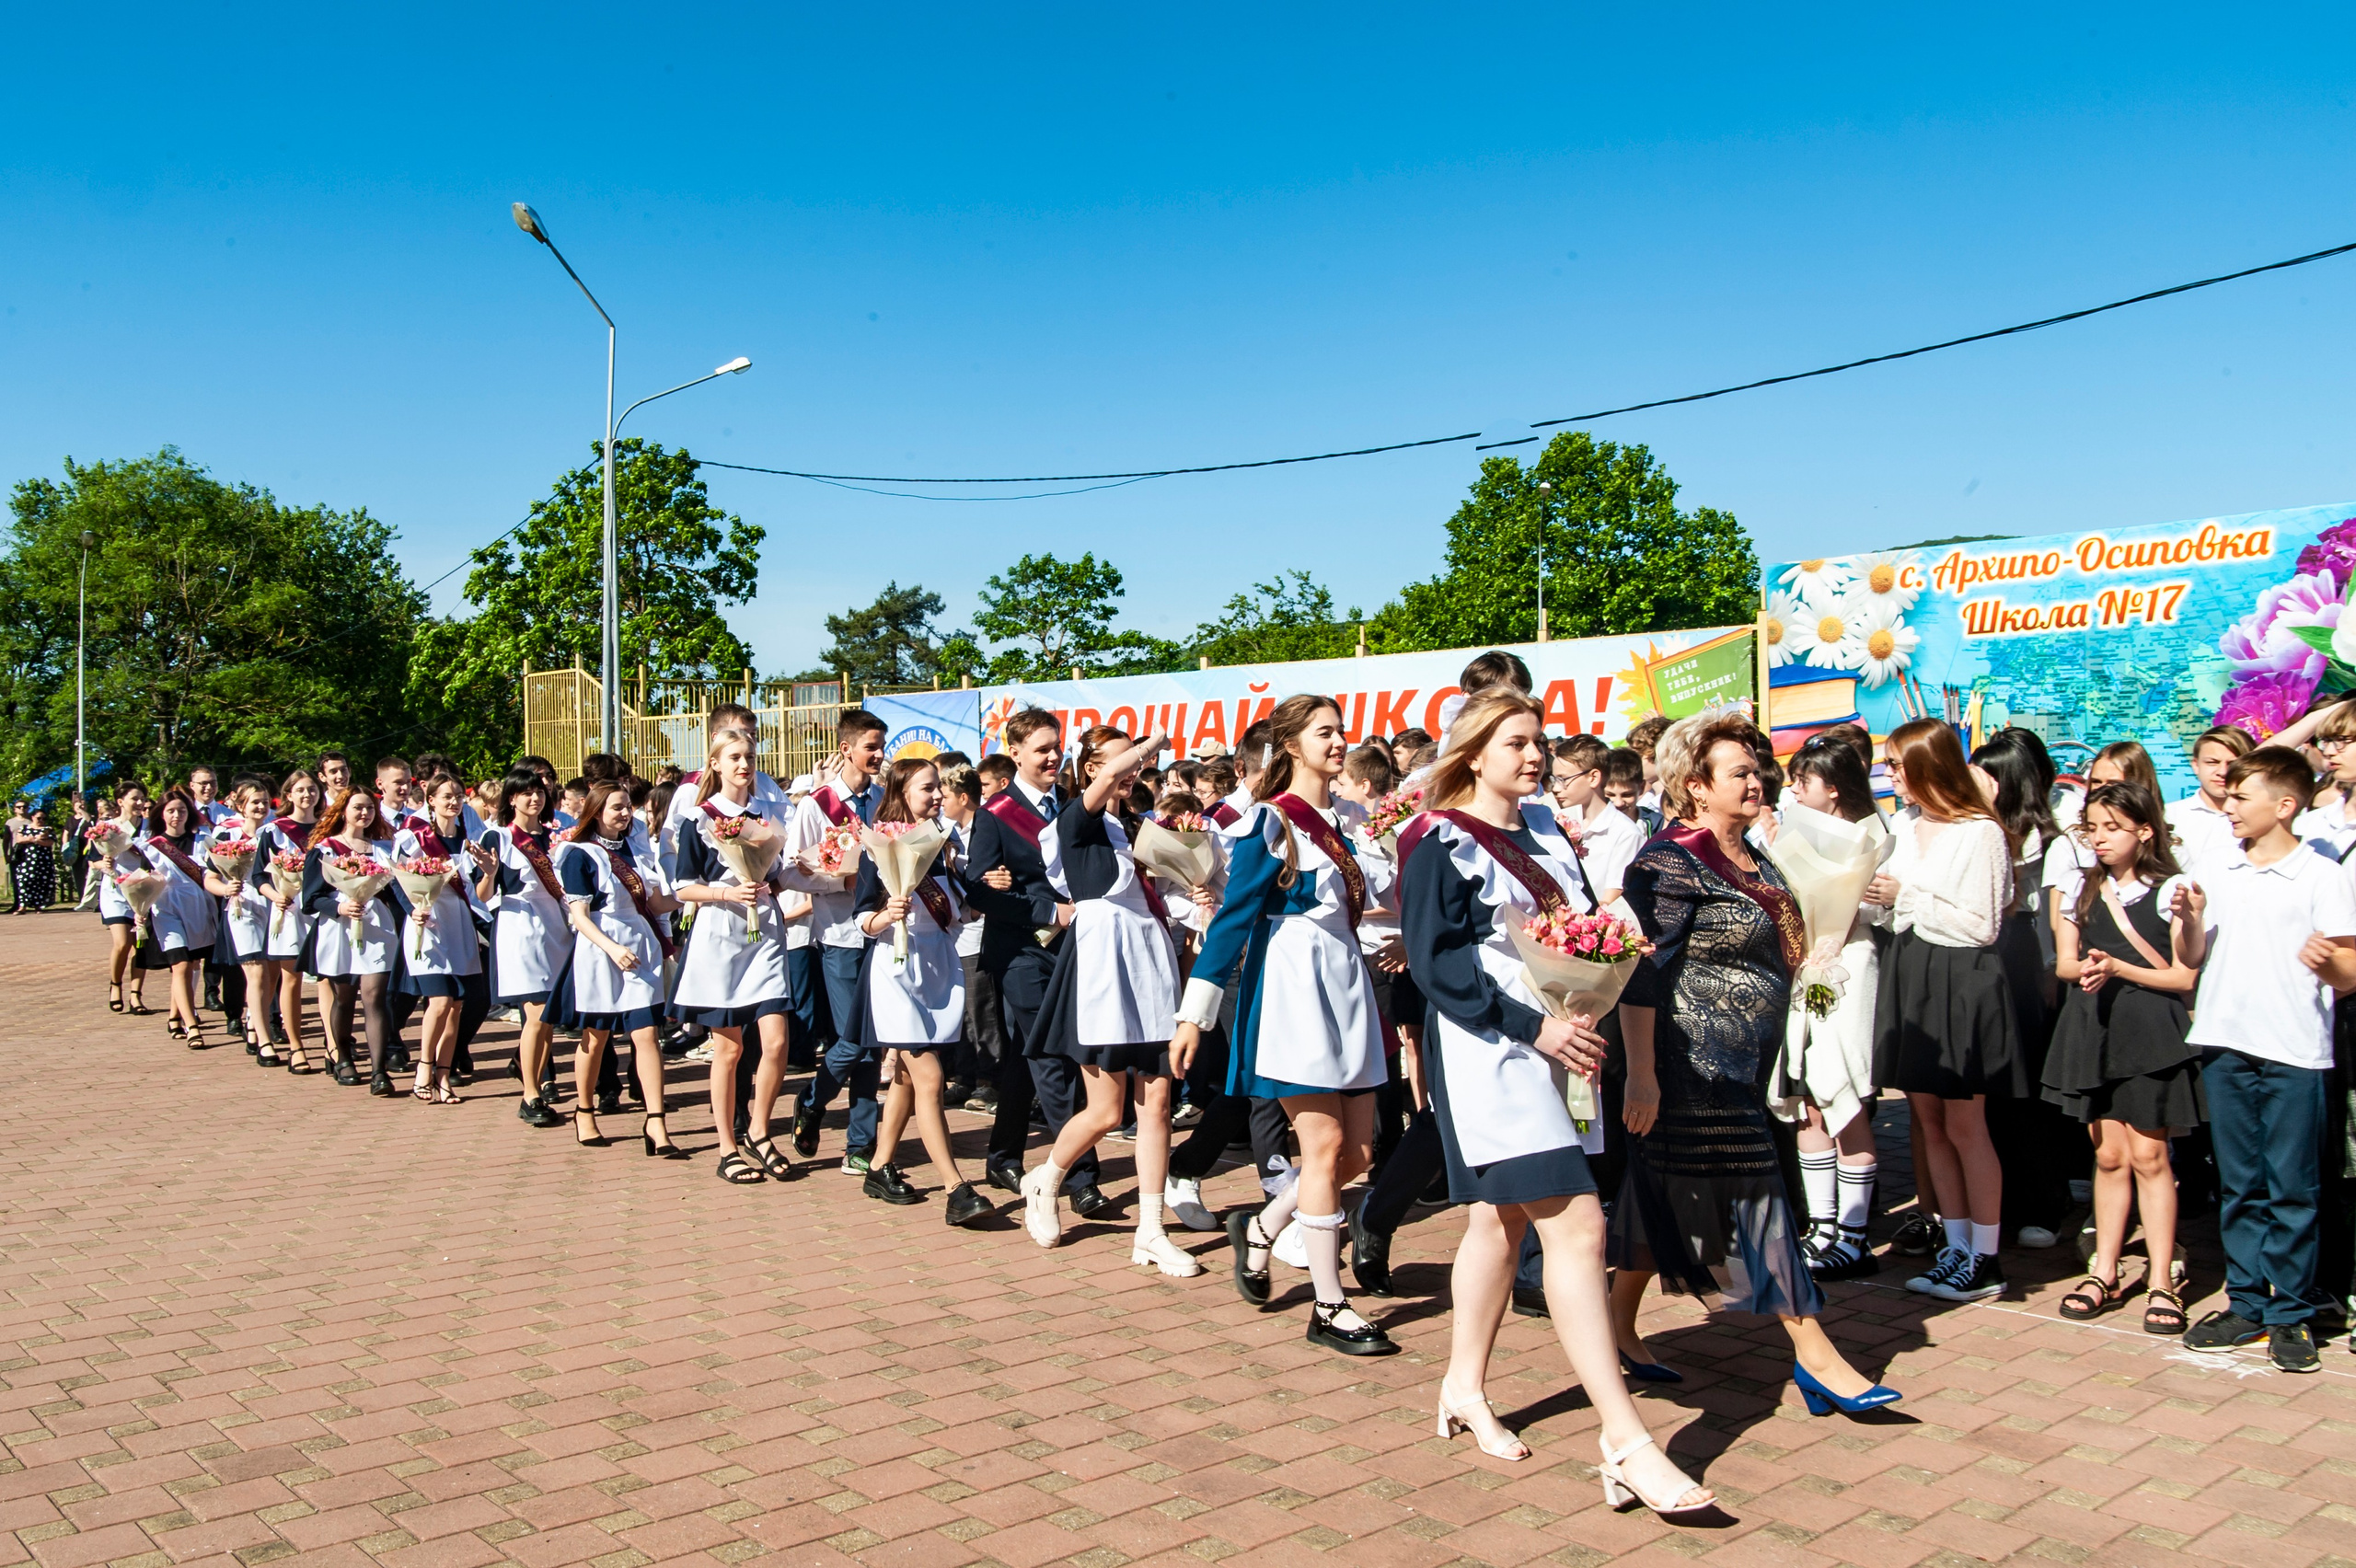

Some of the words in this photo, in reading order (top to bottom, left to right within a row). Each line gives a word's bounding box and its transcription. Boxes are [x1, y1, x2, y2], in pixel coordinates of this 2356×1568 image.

[1899, 565, 1923, 588] с.
[1933, 525, 2271, 594] Архипо-Осиповка
[1962, 600, 2088, 635] Школа
[2097, 584, 2187, 625] №17
[1663, 659, 1698, 678] УДАЧИ
[1667, 674, 1701, 691] ТЕБЕ,
[1669, 672, 1737, 704] ВЫПУСКНИК!
[1319, 676, 1614, 744] ШКОА!
[884, 729, 917, 759] УБАНИ!
[918, 729, 932, 743] НА
[933, 734, 950, 754] БЛА
